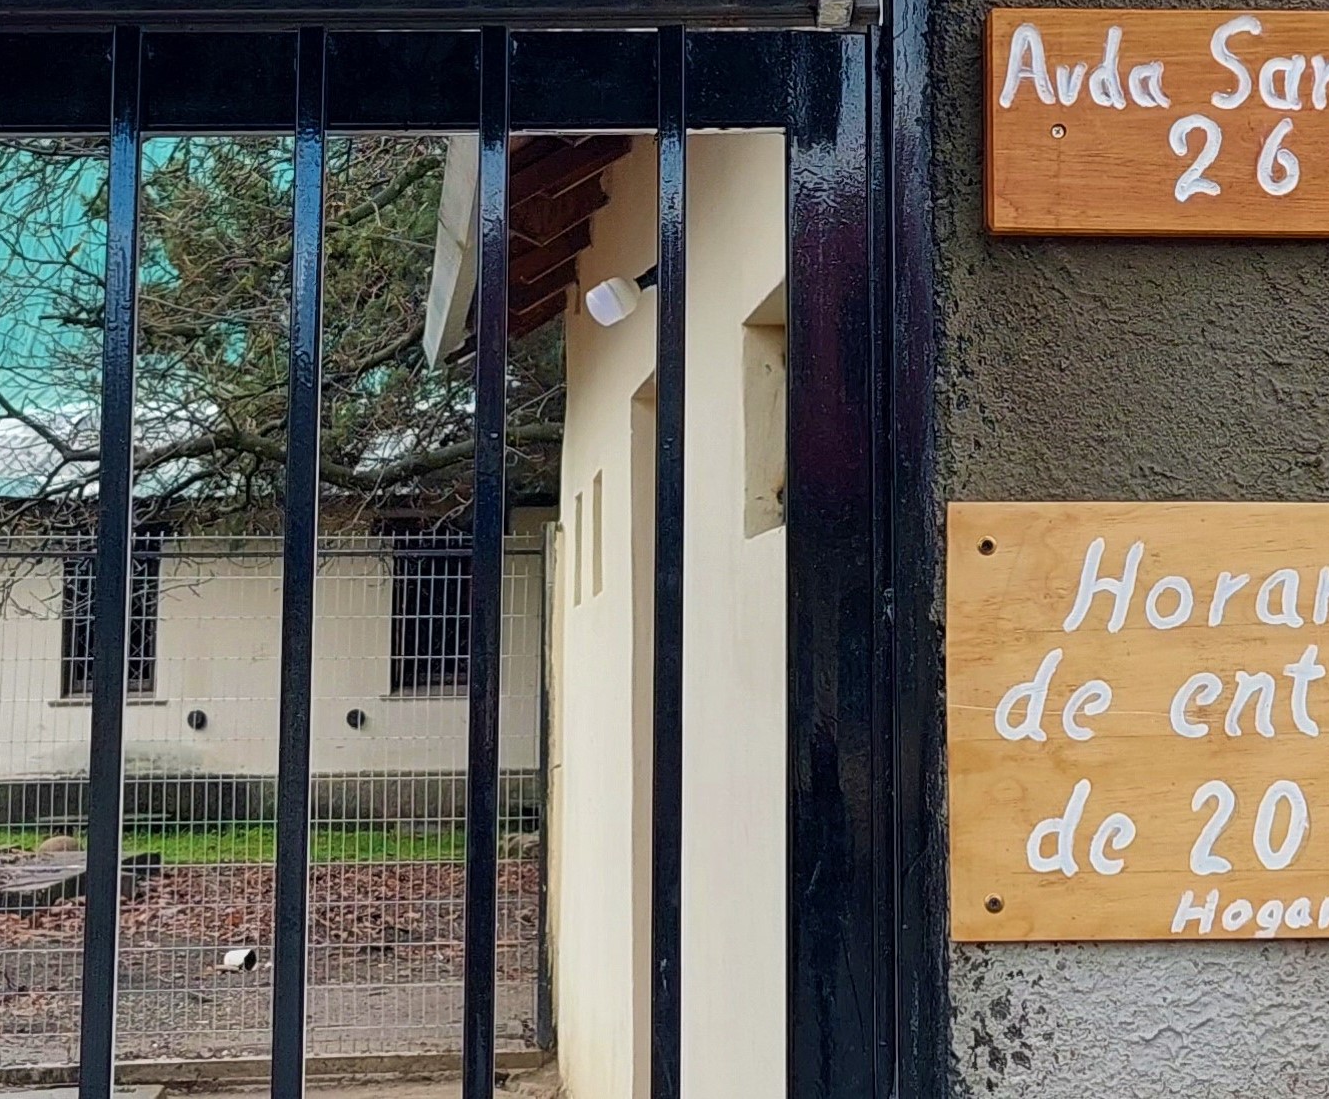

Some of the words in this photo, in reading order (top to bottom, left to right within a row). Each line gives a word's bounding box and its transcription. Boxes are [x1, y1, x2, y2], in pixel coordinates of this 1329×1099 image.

[999, 23, 1170, 109] Avda
[995, 647, 1113, 741] de
[1026, 779, 1136, 879] de
[1189, 779, 1309, 876] 20
